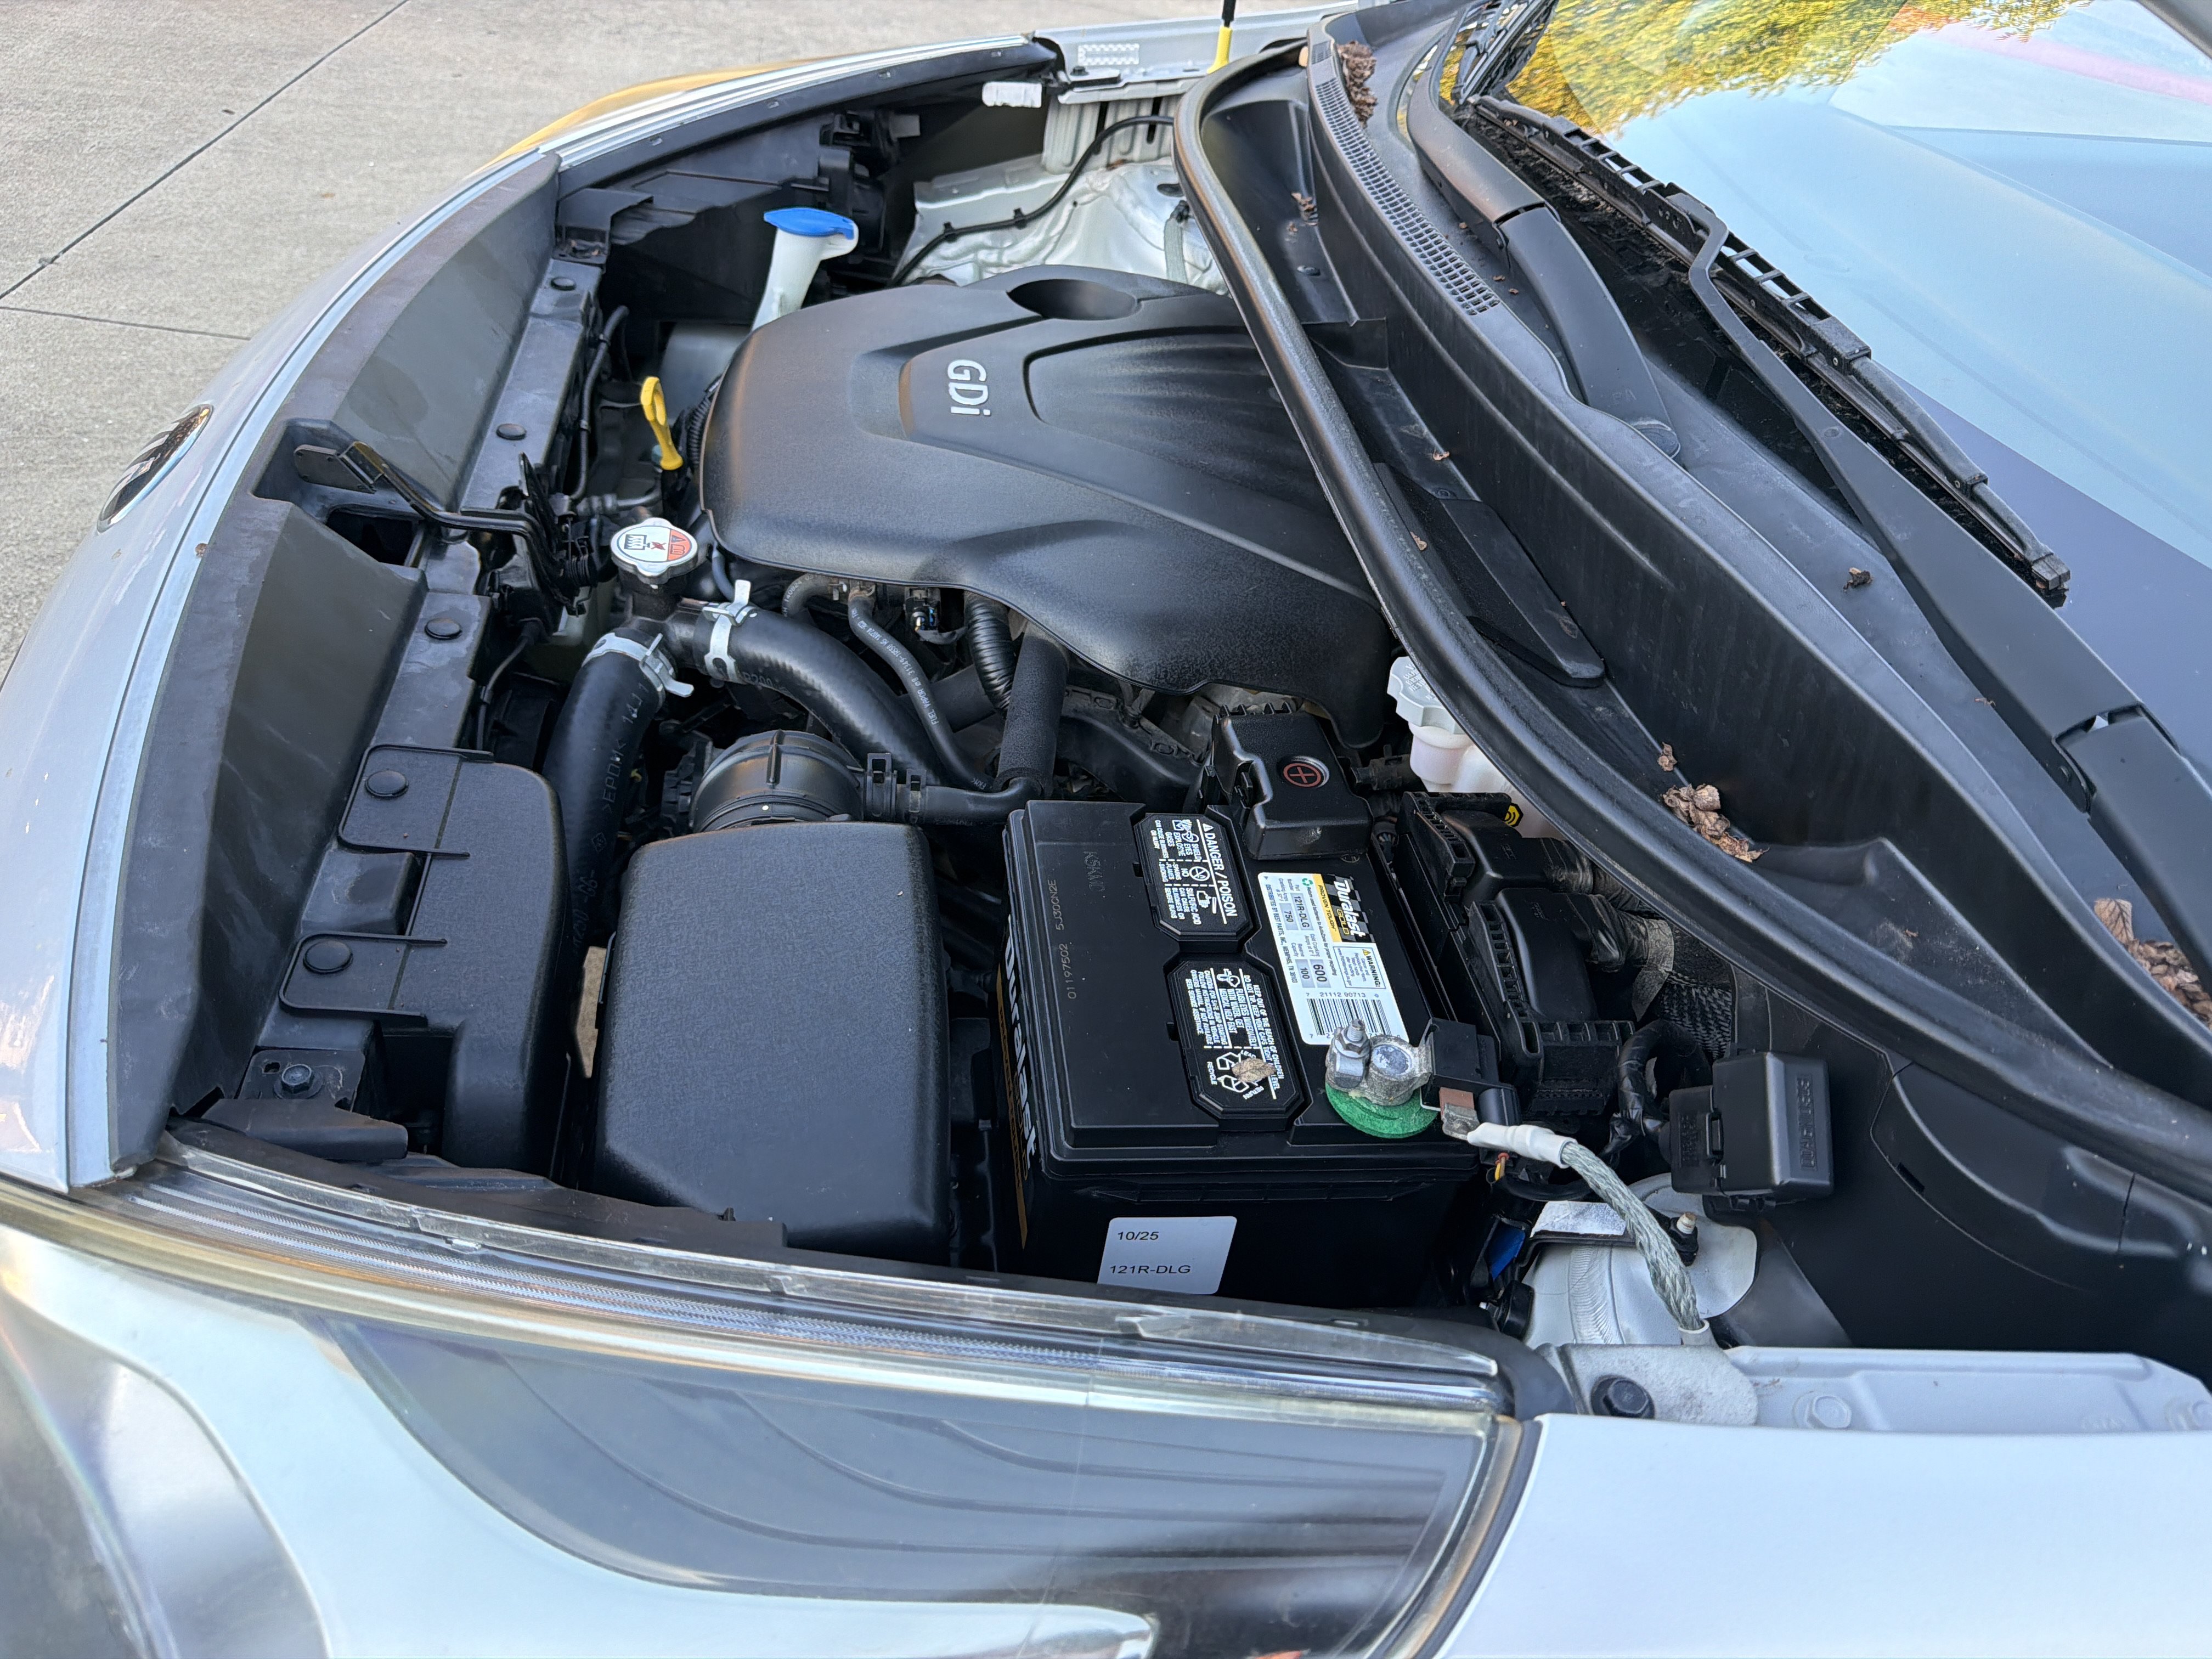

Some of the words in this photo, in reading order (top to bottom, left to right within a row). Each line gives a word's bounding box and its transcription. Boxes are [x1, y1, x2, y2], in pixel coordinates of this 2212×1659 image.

[947, 359, 991, 416] GDi
[917, 688, 931, 708] VAPOR
[928, 709, 939, 725] FUEL
[1165, 832, 1175, 847] GASES
[1183, 843, 1193, 855] EYES
[1191, 843, 1201, 860] SHIELD
[1181, 868, 1189, 877] NO
[1204, 833, 1224, 870] DANGER
[1217, 880, 1237, 916] POISON
[1164, 887, 1173, 903] SEVERE
[1186, 888, 1198, 912] SULFURIC
[1318, 884, 1329, 908] PROVEN
[1181, 898, 1189, 912] CAUSE
[1294, 896, 1309, 927] 121R-DLG
[1334, 880, 1366, 937] Duralast
[1191, 912, 1201, 924] ACID
[1284, 911, 1294, 922] 750
[1336, 909, 1349, 934] GOLD
[1265, 884, 1276, 906] DISTRIBUTED
[1273, 913, 1281, 922] BEST
[1289, 971, 1297, 983] 38103
[1059, 943, 1076, 999] 01197502
[1300, 967, 1310, 979] 100
[1313, 964, 1327, 981] 600
[1366, 956, 1381, 987] WARNING:
[1218, 988, 1229, 1007] MEDICAL
[1235, 988, 1246, 1003] FLUSH
[1252, 984, 1261, 997] KEEP
[1227, 988, 1237, 1000] WITH
[1235, 1018, 1244, 1028] GET
[1239, 1003, 1249, 1015] EYES
[1256, 997, 1265, 1008] OUT
[1223, 1008, 1233, 1020] HELP
[1251, 1005, 1260, 1017] KEEP
[1227, 1022, 1237, 1033] FAST
[1255, 1018, 1264, 1030] VENT
[1261, 1017, 1270, 1027] THE
[1005, 915, 1036, 1170] Duralast
[1259, 1031, 1268, 1045] CAPS
[1264, 1028, 1274, 1045] REACH
[1262, 1046, 1272, 1060] TIGHT
[1207, 1061, 1218, 1085] RECYCLE
[1272, 1054, 1284, 1079] CHILDREN
[1271, 1074, 1280, 1090] LEVEL
[1118, 1231, 1159, 1240] 10/25
[1110, 1265, 1191, 1274] 121R-DLG
